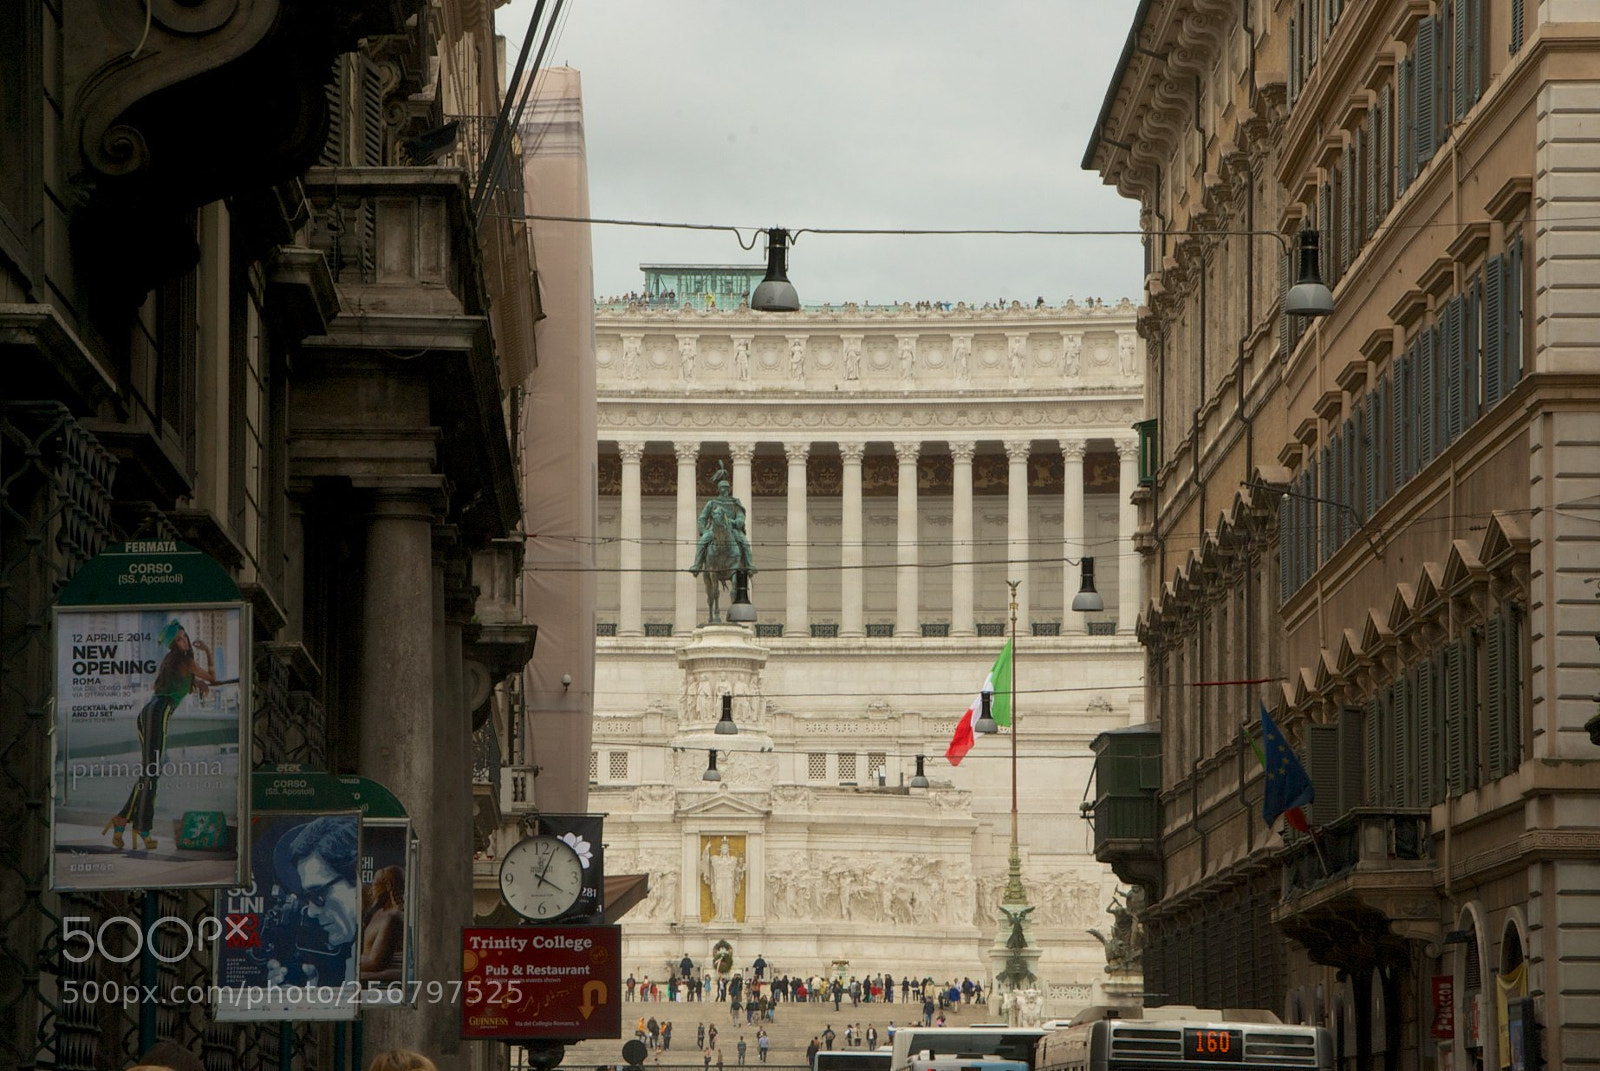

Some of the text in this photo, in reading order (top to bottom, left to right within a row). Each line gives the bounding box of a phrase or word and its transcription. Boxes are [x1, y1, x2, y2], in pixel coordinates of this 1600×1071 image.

[125, 541, 177, 553] FERMATA
[129, 563, 173, 574] CORSO
[118, 573, 183, 585] (SS. Apostoli)
[72, 633, 151, 643] 12 APRILE 2014
[72, 645, 118, 660] NEW
[72, 660, 157, 675] OPENING
[72, 750, 223, 791] primadonna
[273, 779, 307, 788] CORSO
[227, 897, 264, 914] LINI
[469, 936, 592, 951] Trinity College
[485, 964, 590, 975] Pub & Restaurant
[468, 1015, 509, 1026] GUINNESS
[1195, 1030, 1230, 1053] 160
